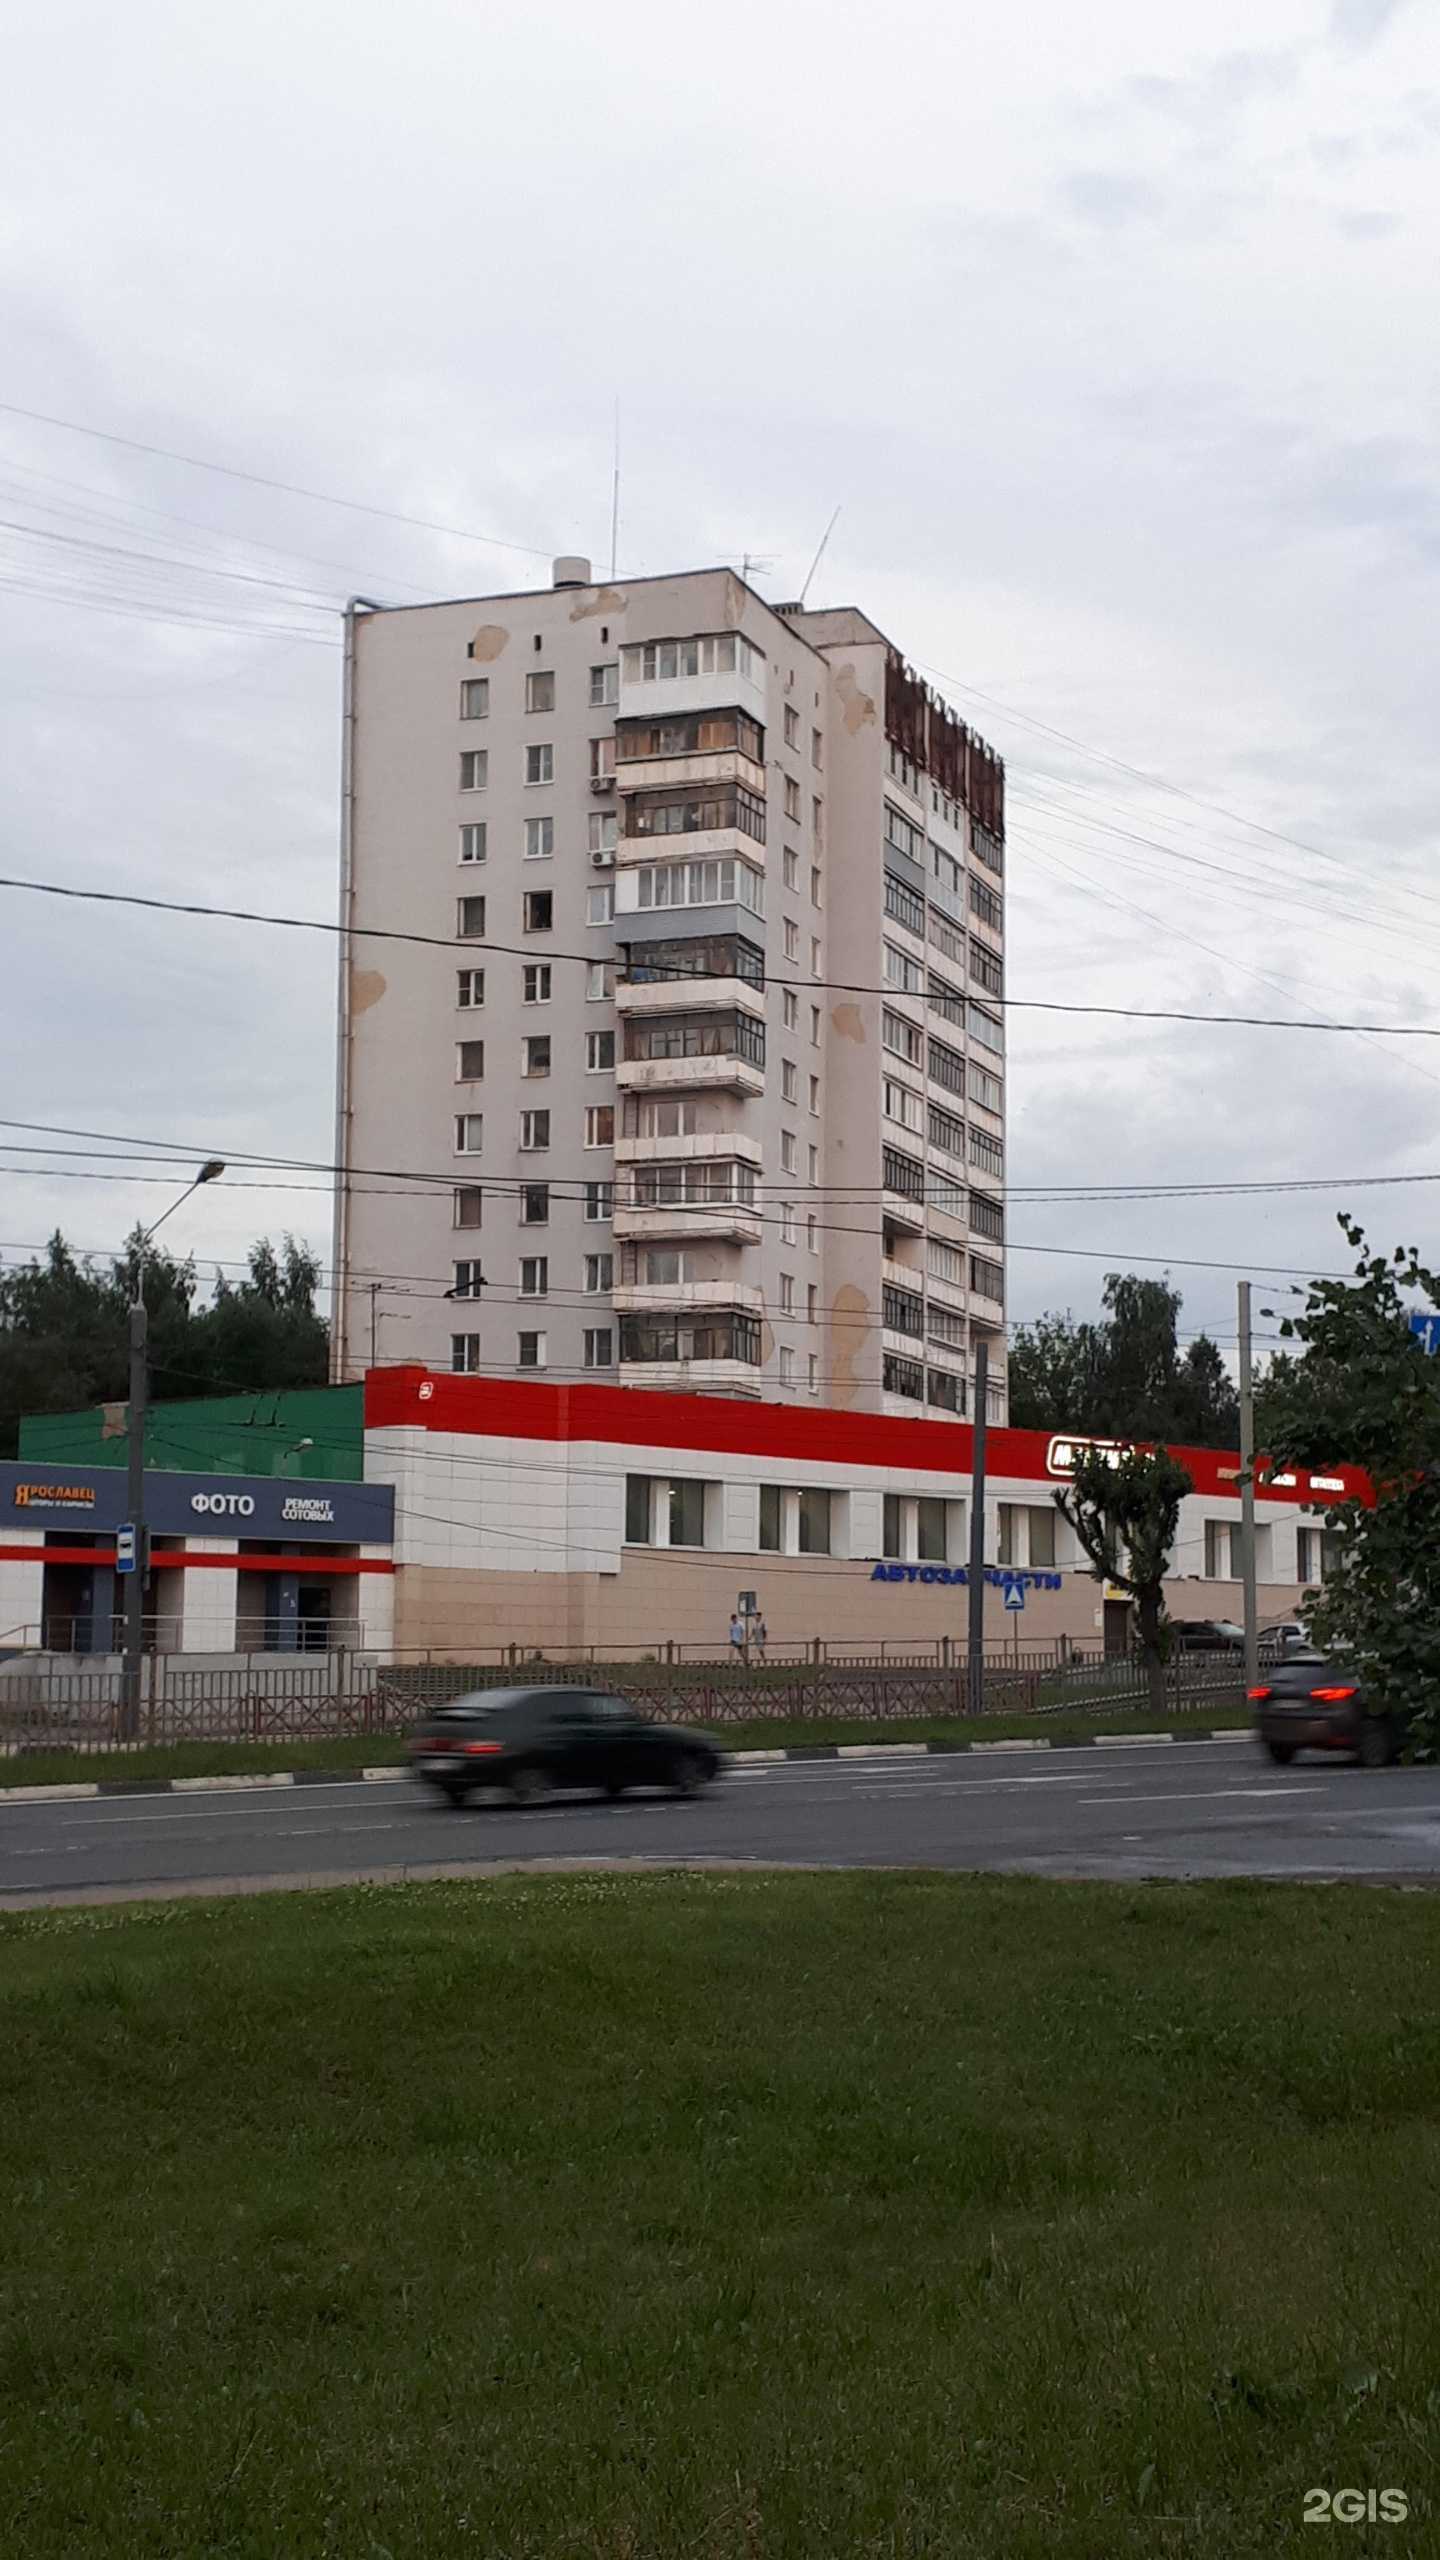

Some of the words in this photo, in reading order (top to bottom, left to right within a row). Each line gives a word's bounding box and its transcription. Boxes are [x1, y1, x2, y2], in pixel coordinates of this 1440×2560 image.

[16, 1484, 96, 1504] ЯРОСЛАВЕЦ
[191, 1493, 255, 1516] ФОТО
[285, 1498, 331, 1511] РЕМОНТ
[281, 1509, 334, 1521] СОТОВЫХ
[871, 1564, 1062, 1590] АВТОЗАЧАСТИ
